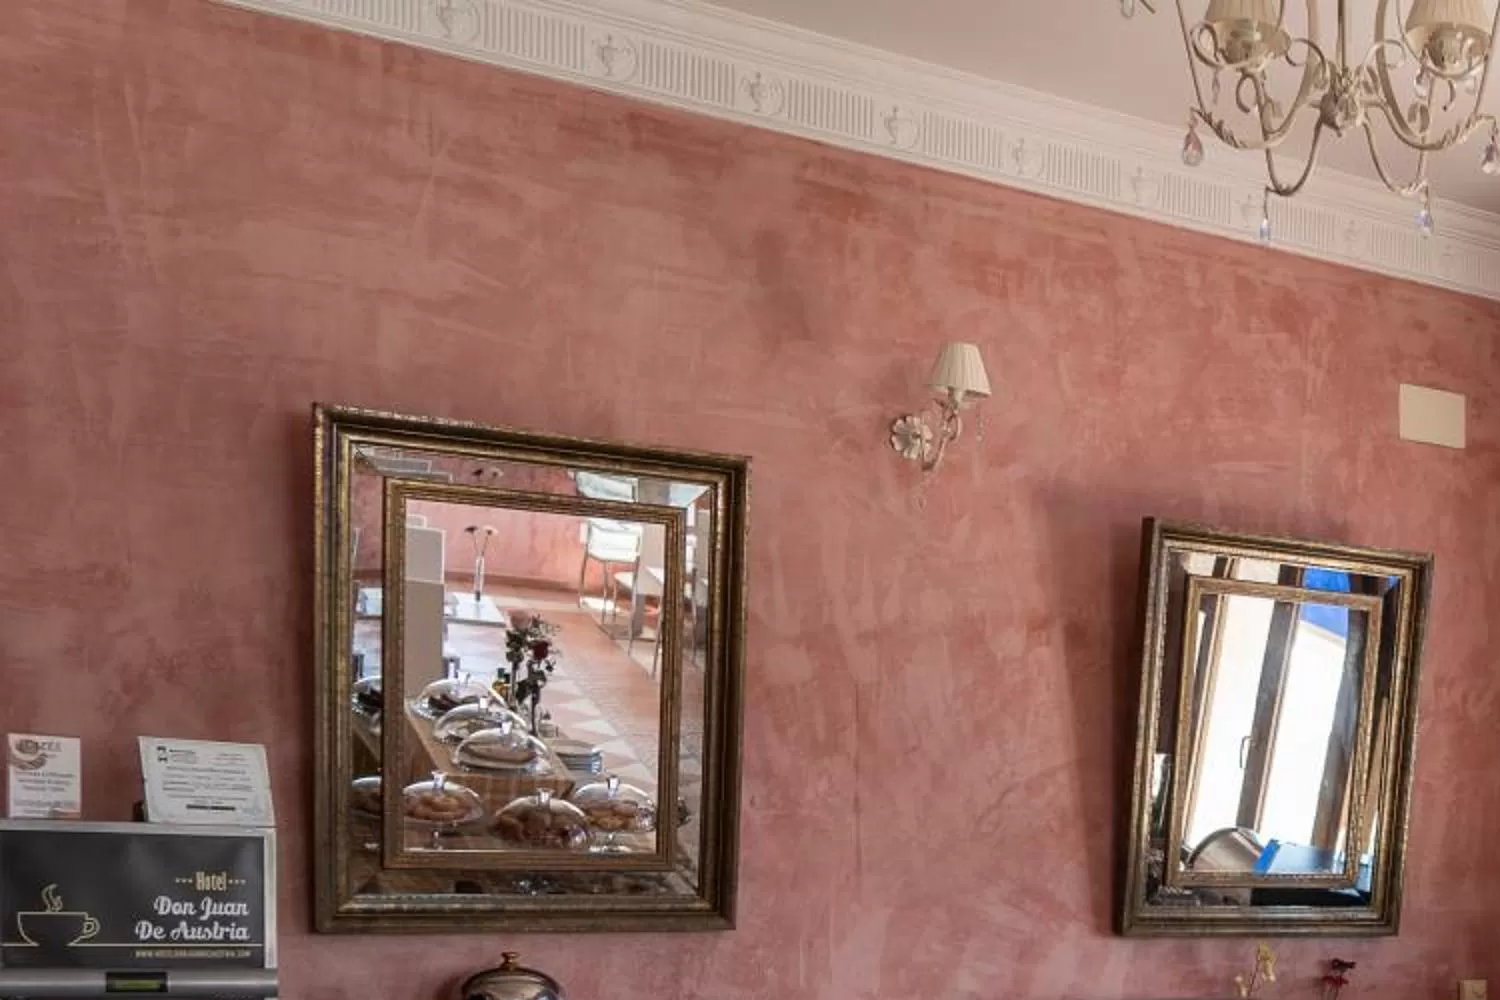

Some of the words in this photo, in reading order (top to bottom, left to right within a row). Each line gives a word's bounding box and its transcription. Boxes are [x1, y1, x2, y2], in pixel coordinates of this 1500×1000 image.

[195, 871, 227, 891] Hotel
[153, 895, 197, 916] Don
[199, 895, 250, 921] Juan
[135, 920, 166, 940] De
[169, 920, 250, 940] Austria
